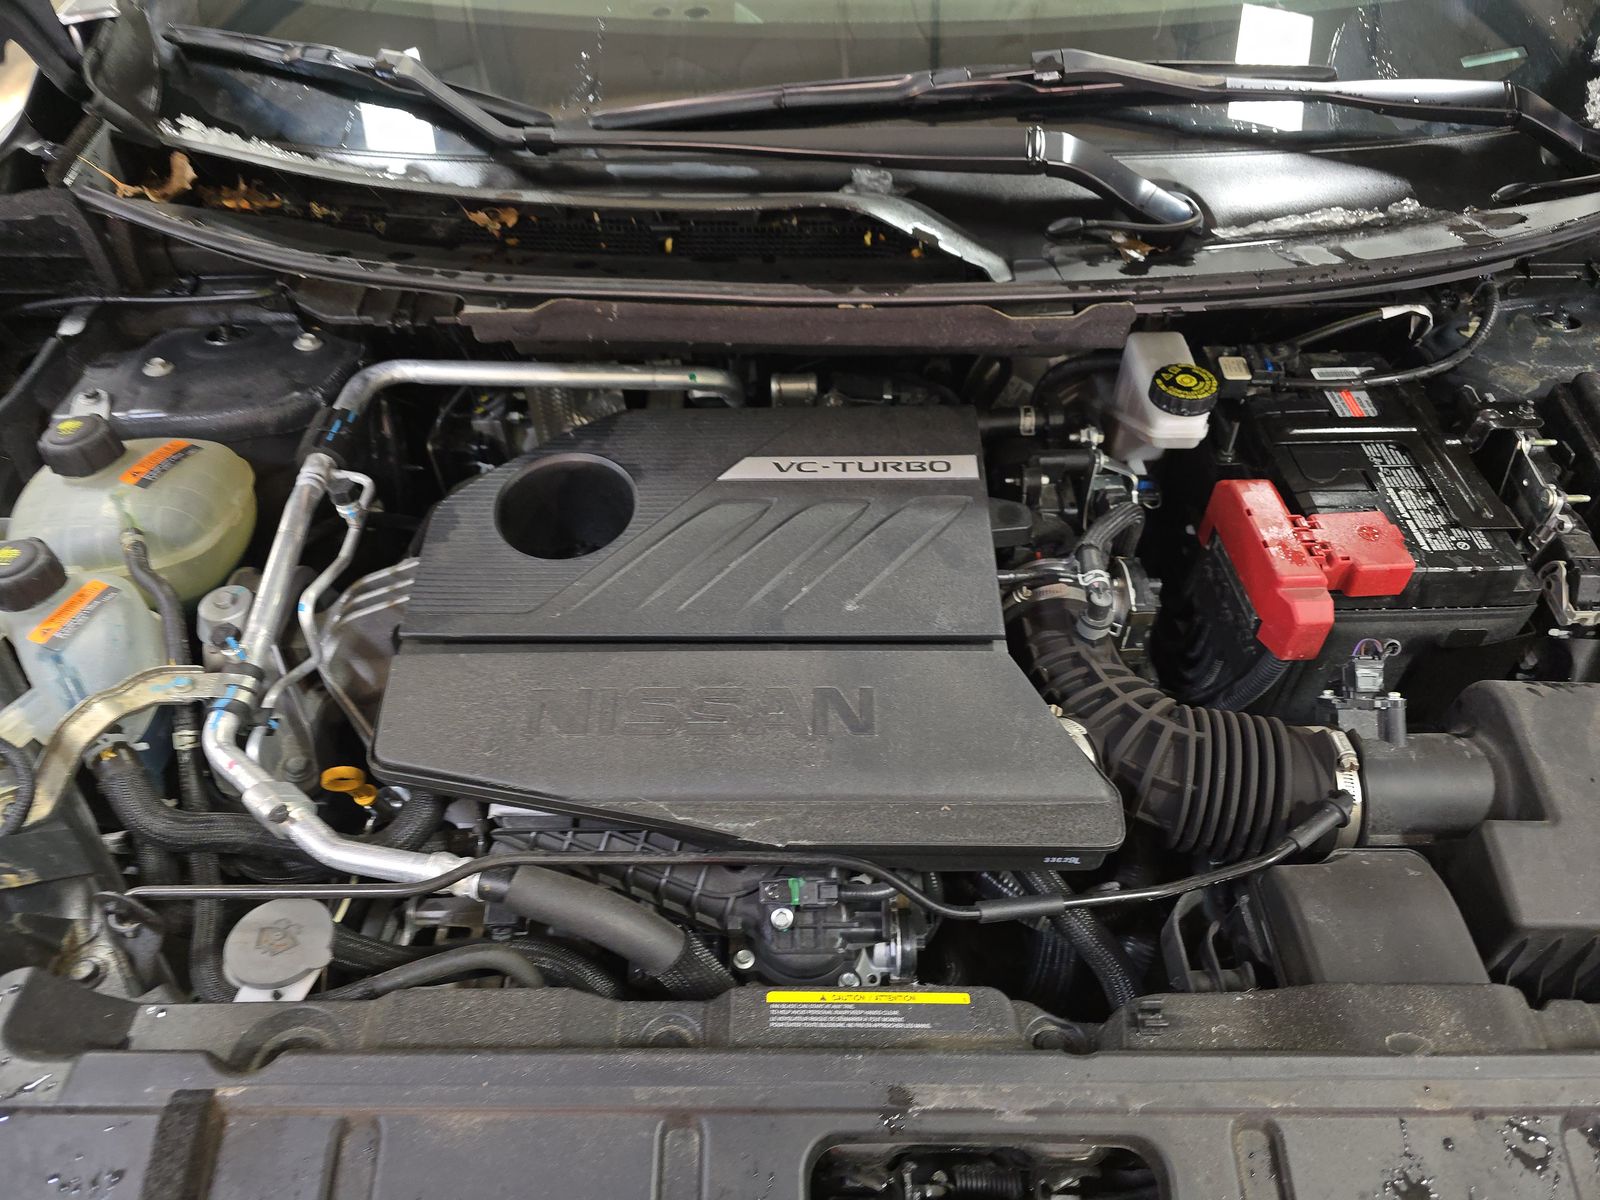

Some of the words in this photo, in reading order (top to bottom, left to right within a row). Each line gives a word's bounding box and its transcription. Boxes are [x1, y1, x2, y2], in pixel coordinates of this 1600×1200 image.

[772, 460, 952, 474] VC-TURBO
[527, 685, 877, 738] NISSAN
[831, 994, 866, 1002] CAUTION
[874, 995, 917, 1003] ATTENTION
